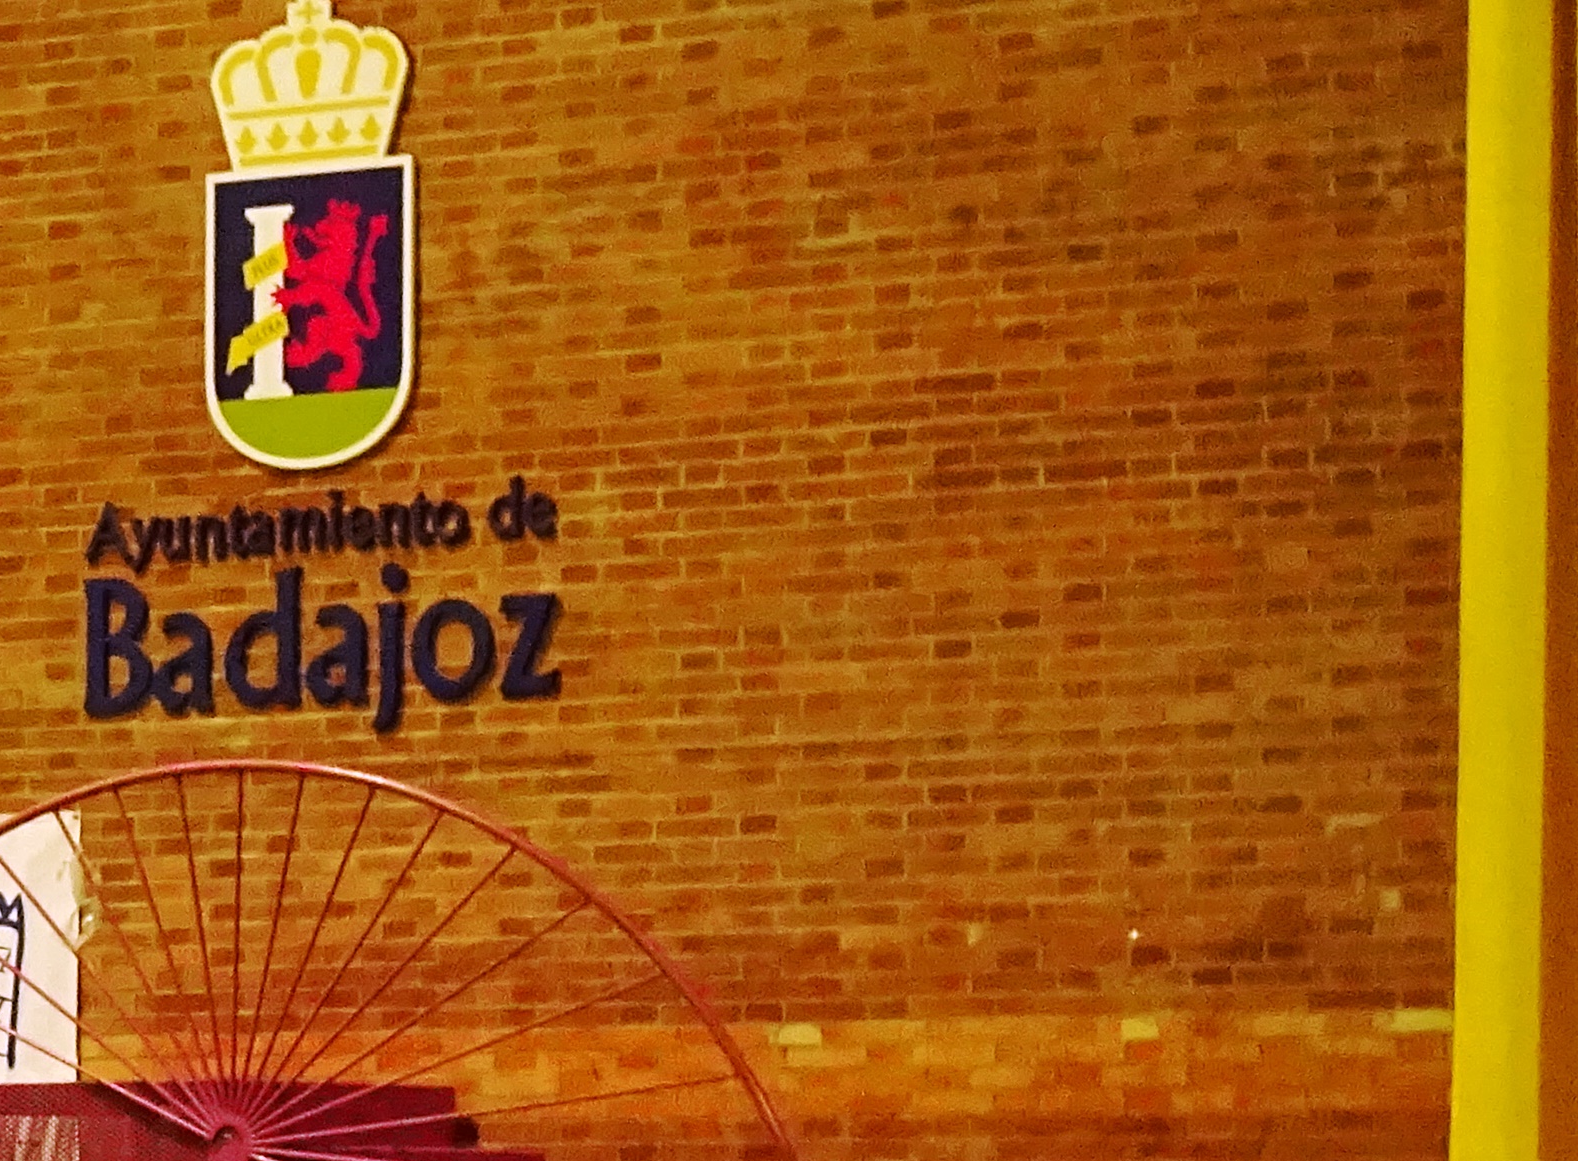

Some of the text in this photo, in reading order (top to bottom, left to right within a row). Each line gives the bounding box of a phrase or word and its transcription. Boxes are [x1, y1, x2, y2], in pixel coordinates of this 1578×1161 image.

[85, 475, 559, 575] Ayuntamiento de
[84, 562, 563, 736] Badajoz
